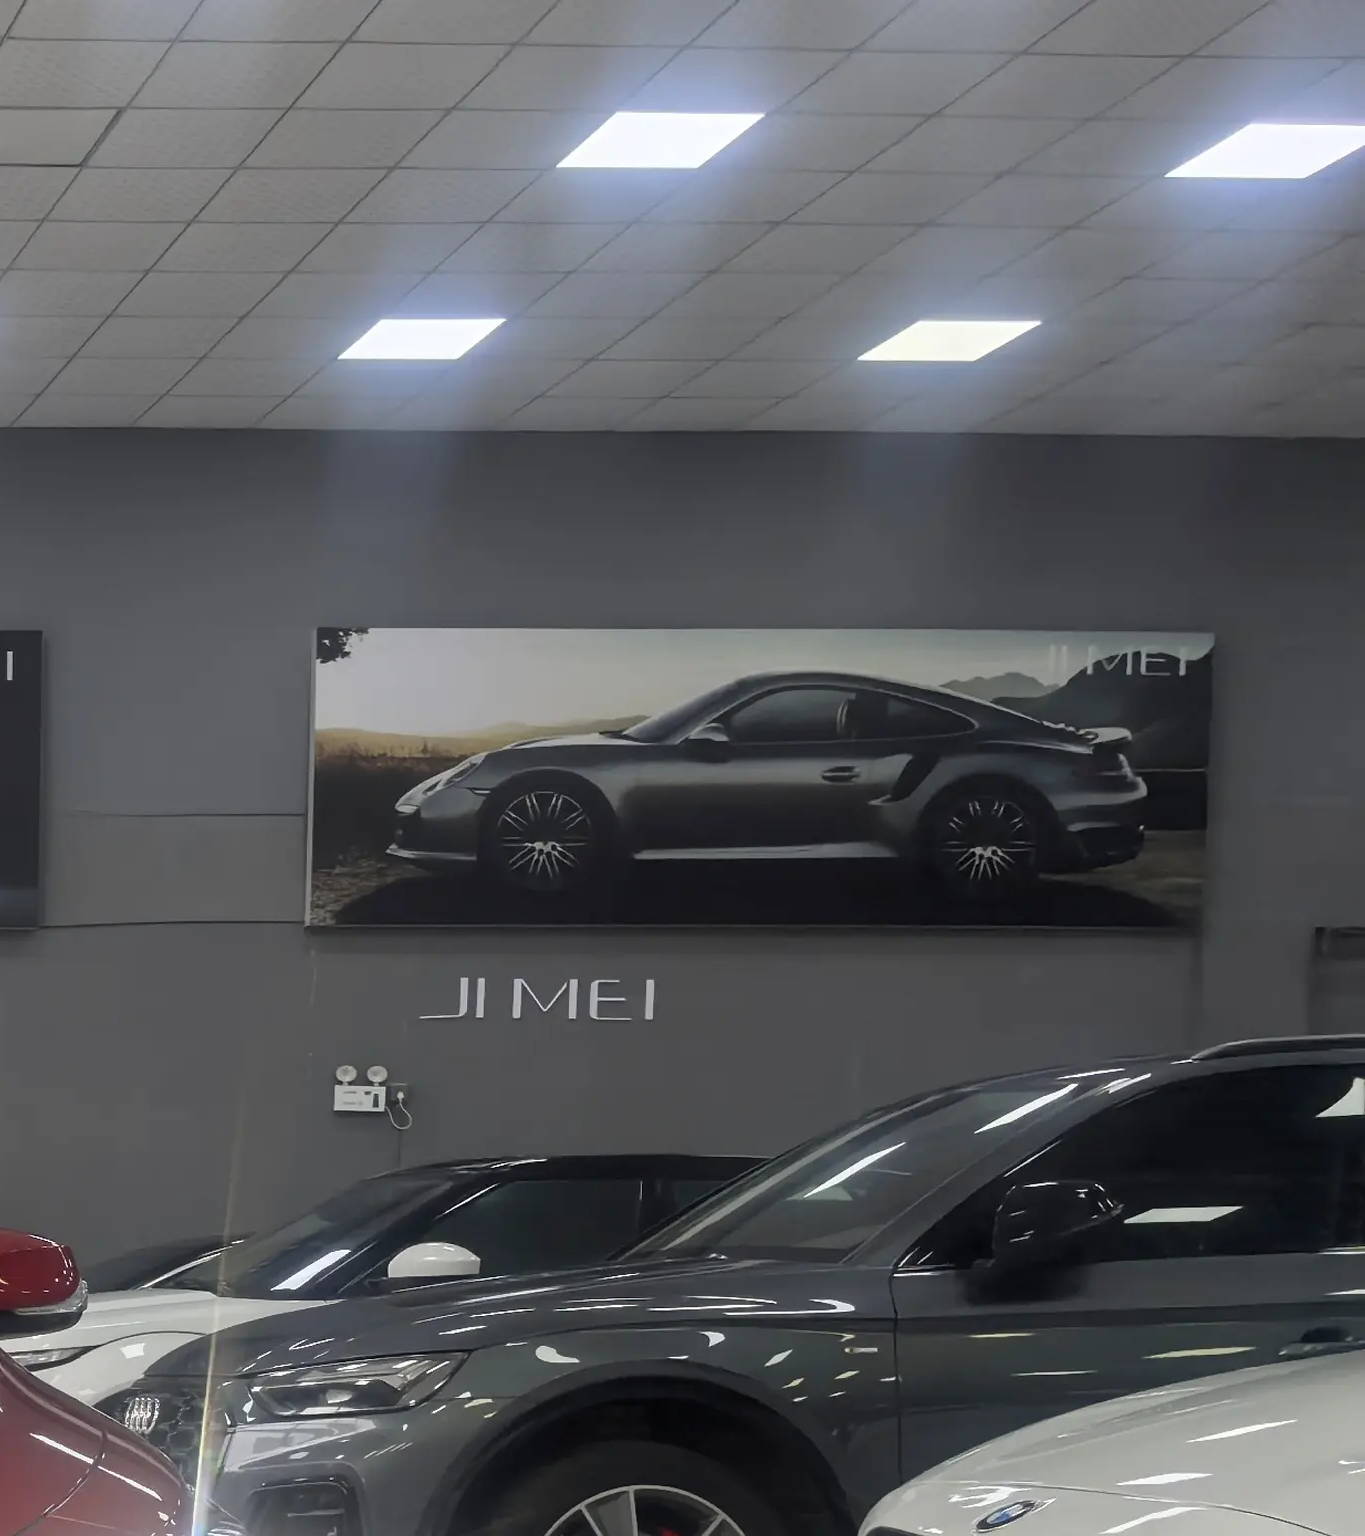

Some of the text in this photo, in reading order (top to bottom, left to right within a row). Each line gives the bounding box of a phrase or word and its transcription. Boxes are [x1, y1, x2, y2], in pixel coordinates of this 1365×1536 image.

[1086, 645, 1188, 677] MEI
[418, 976, 656, 1021] JI MEI
